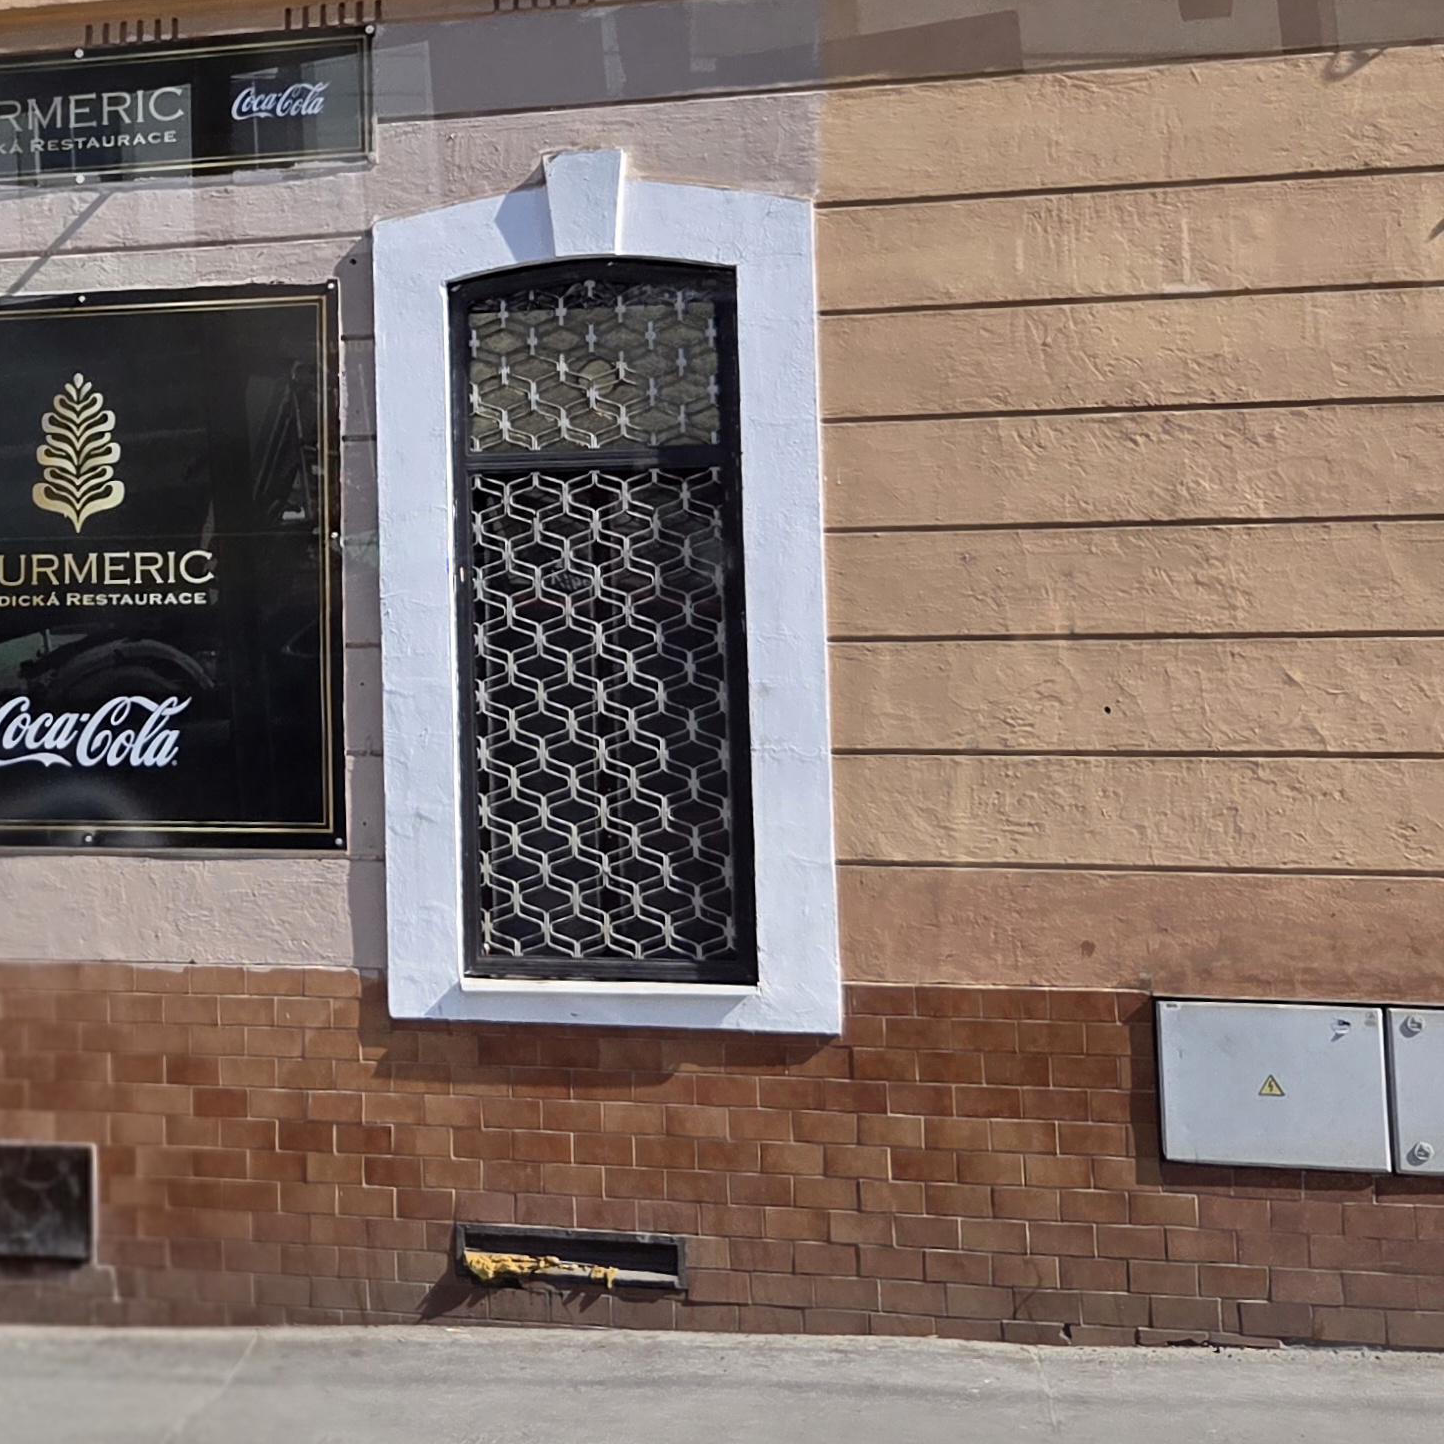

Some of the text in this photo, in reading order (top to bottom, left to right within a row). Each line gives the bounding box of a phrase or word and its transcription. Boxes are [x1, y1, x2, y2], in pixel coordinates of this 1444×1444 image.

[231, 81, 331, 120] Coca-Cola
[30, 130, 177, 153] RESTAURACE
[66, 591, 207, 606] RESTAURACE
